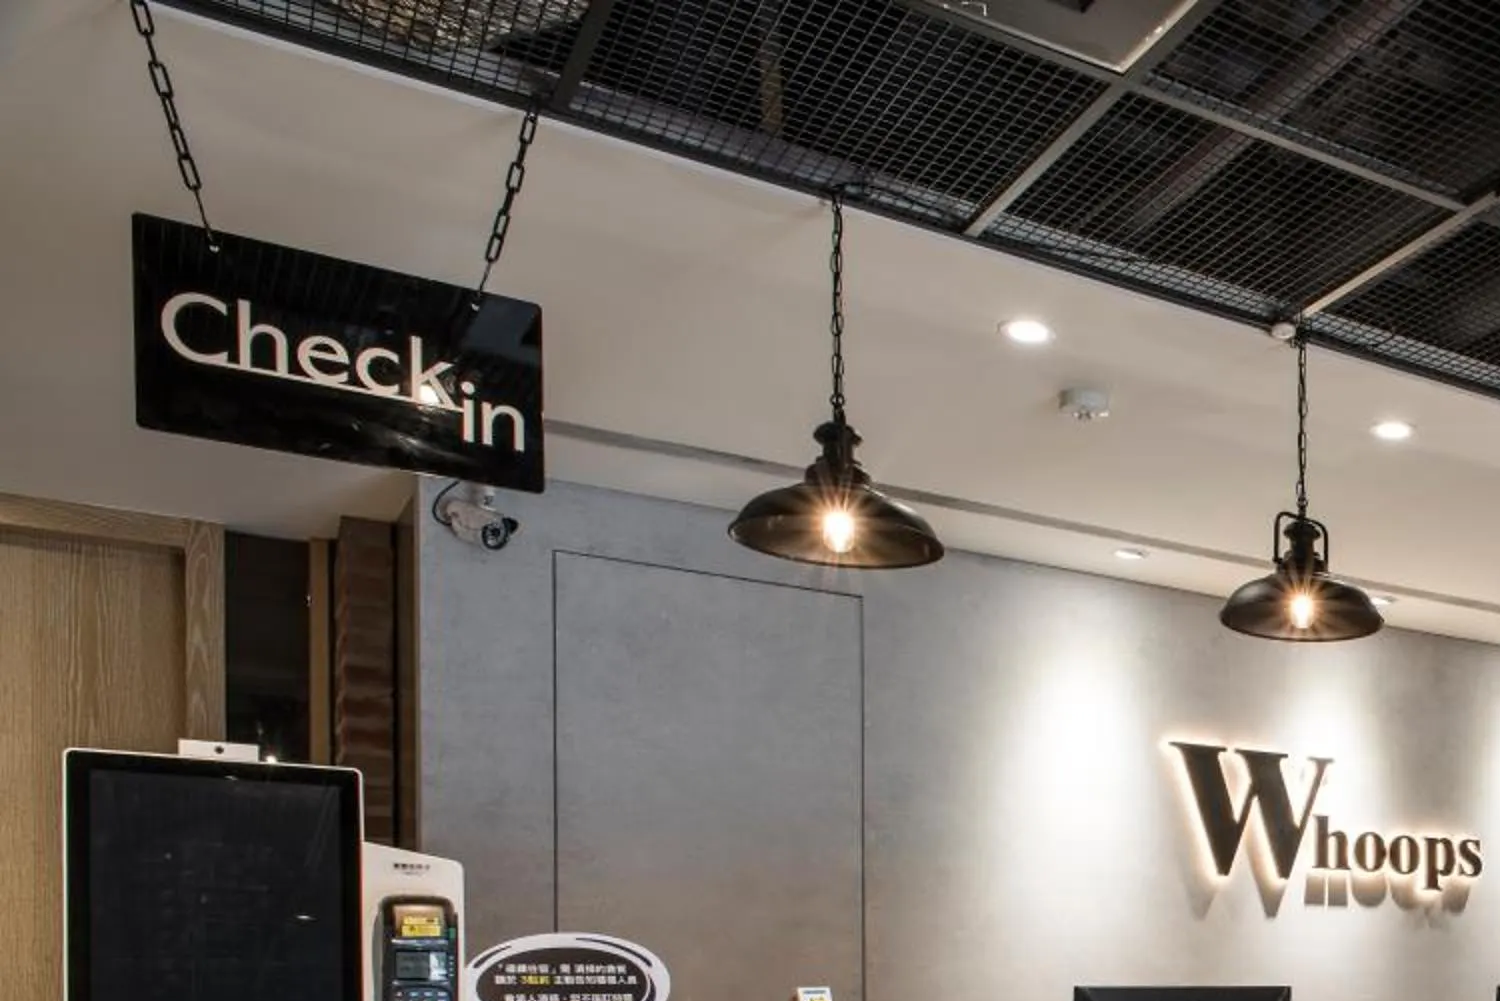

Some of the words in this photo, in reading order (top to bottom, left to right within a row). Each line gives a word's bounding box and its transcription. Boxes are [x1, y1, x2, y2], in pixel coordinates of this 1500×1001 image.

[159, 290, 462, 412] Check
[462, 380, 526, 453] in
[1167, 740, 1484, 892] Whoops
